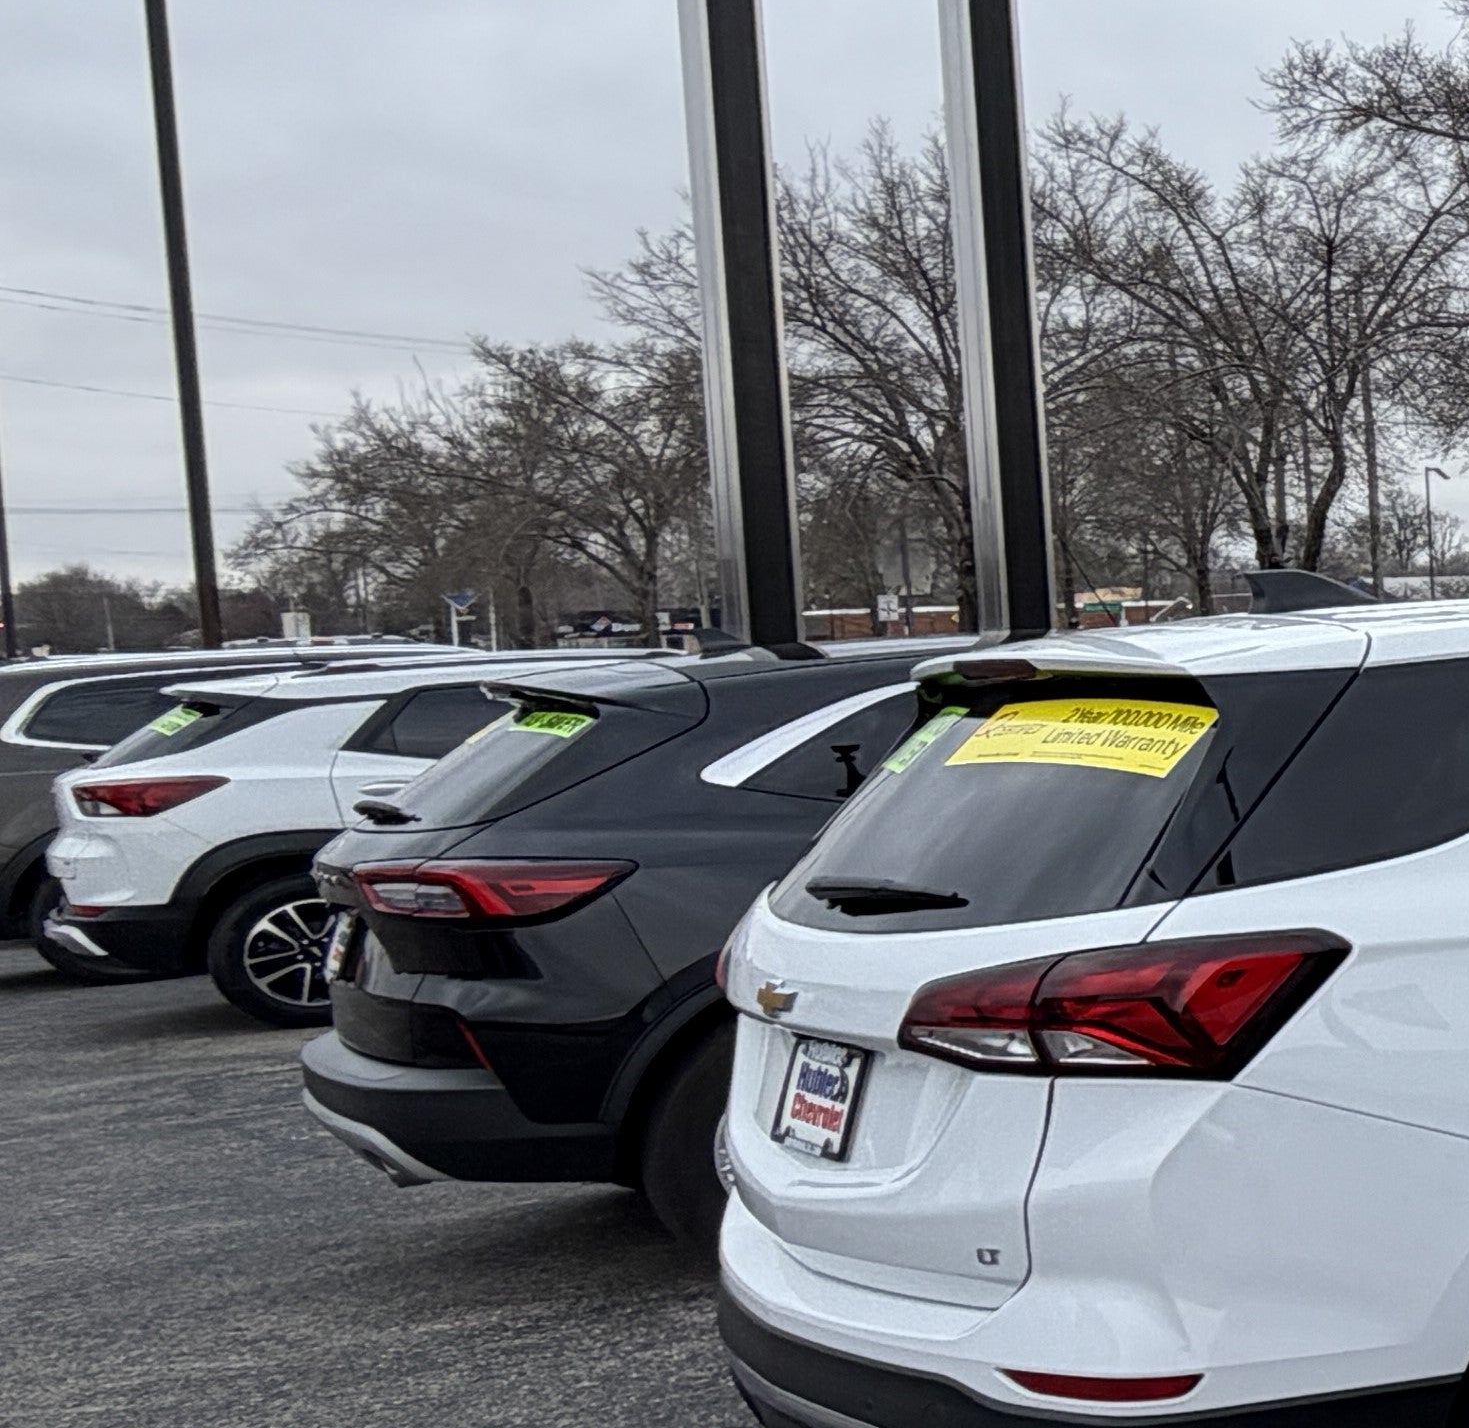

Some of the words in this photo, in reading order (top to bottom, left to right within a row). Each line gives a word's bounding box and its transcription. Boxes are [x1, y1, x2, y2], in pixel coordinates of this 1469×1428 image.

[1042, 728, 1105, 745] Limited
[1101, 729, 1188, 760] Warranty
[796, 1061, 840, 1100] Hubler
[790, 1092, 845, 1134] Chevrolet
